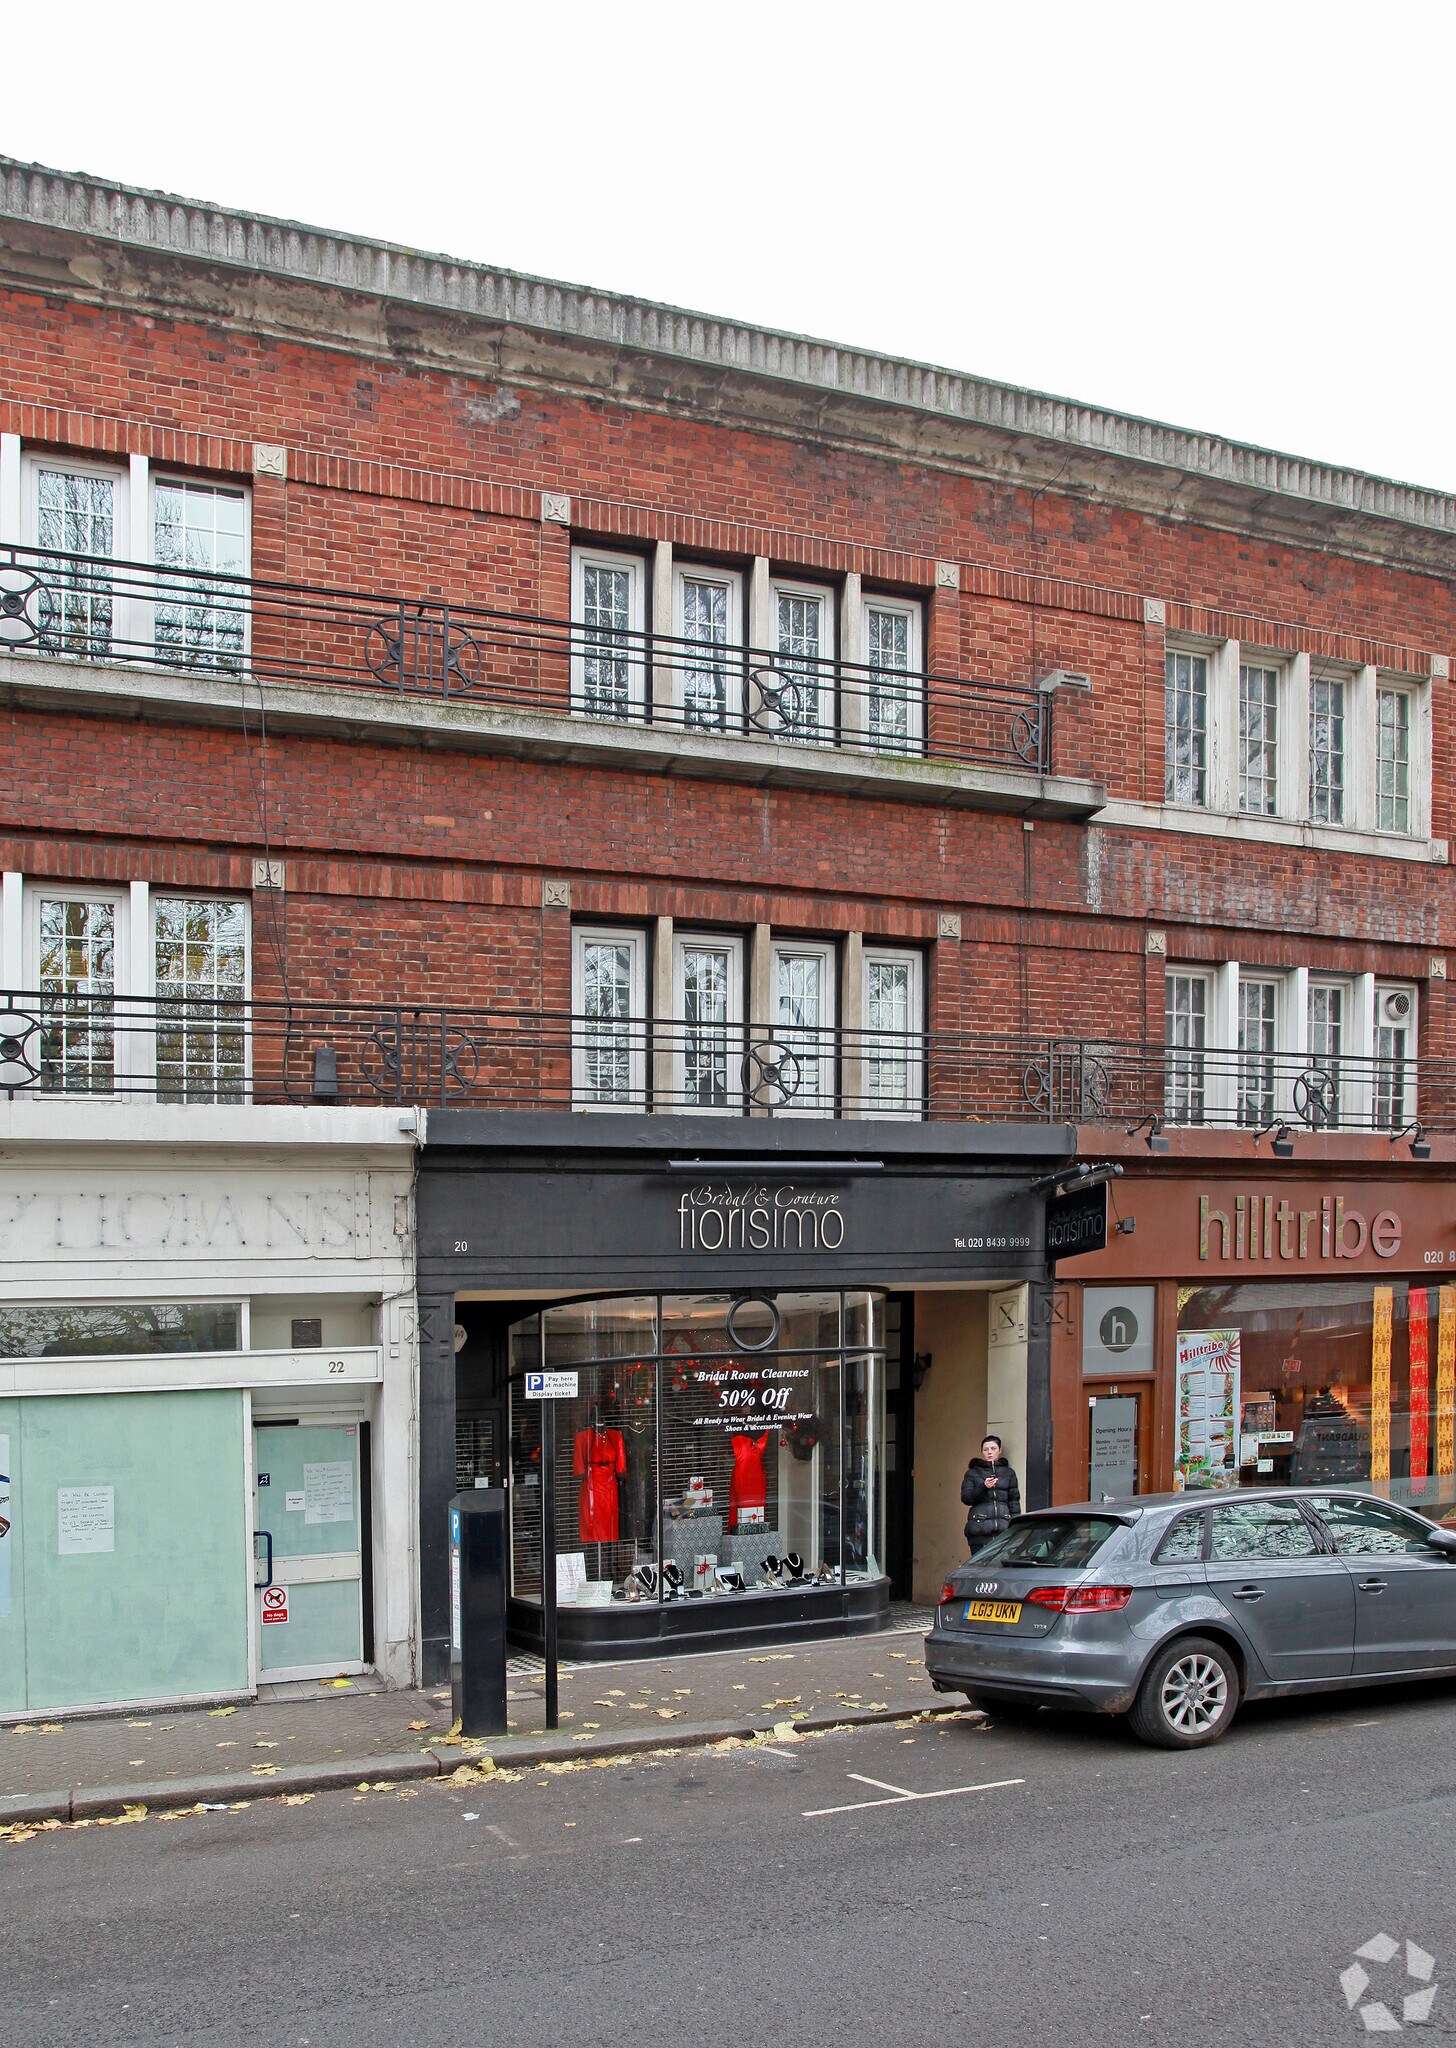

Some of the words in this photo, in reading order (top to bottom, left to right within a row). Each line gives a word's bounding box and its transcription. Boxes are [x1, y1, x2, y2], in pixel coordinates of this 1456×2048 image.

[690, 1182, 755, 1206] Bridal
[755, 1188, 771, 1206] &
[774, 1186, 840, 1207] Couture
[1200, 1195, 1402, 1260] hilltribe
[454, 1241, 468, 1252] 20
[968, 1238, 984, 1248] 020
[986, 1237, 1006, 1248] 8439
[1009, 1237, 1030, 1247] 9999
[1424, 1251, 1444, 1264] 020
[1111, 1315, 1126, 1344] h
[1179, 1342, 1224, 1364] Hilltribe
[328, 1361, 345, 1373] 22
[530, 1375, 542, 1390] P
[697, 1370, 728, 1382] Bridal
[731, 1370, 759, 1381] Room
[761, 1368, 809, 1379] Clearance
[718, 1389, 756, 1408] 50%
[761, 1387, 793, 1409] Off
[693, 1417, 703, 1426] All
[703, 1417, 722, 1426] Ready
[723, 1416, 730, 1424] to
[730, 1415, 746, 1423] Wear
[746, 1414, 765, 1422] Bridal
[773, 1413, 797, 1422] Evening
[797, 1412, 813, 1420] Wear
[972, 1603, 993, 1617] LG13
[995, 1604, 1017, 1620] UKN
